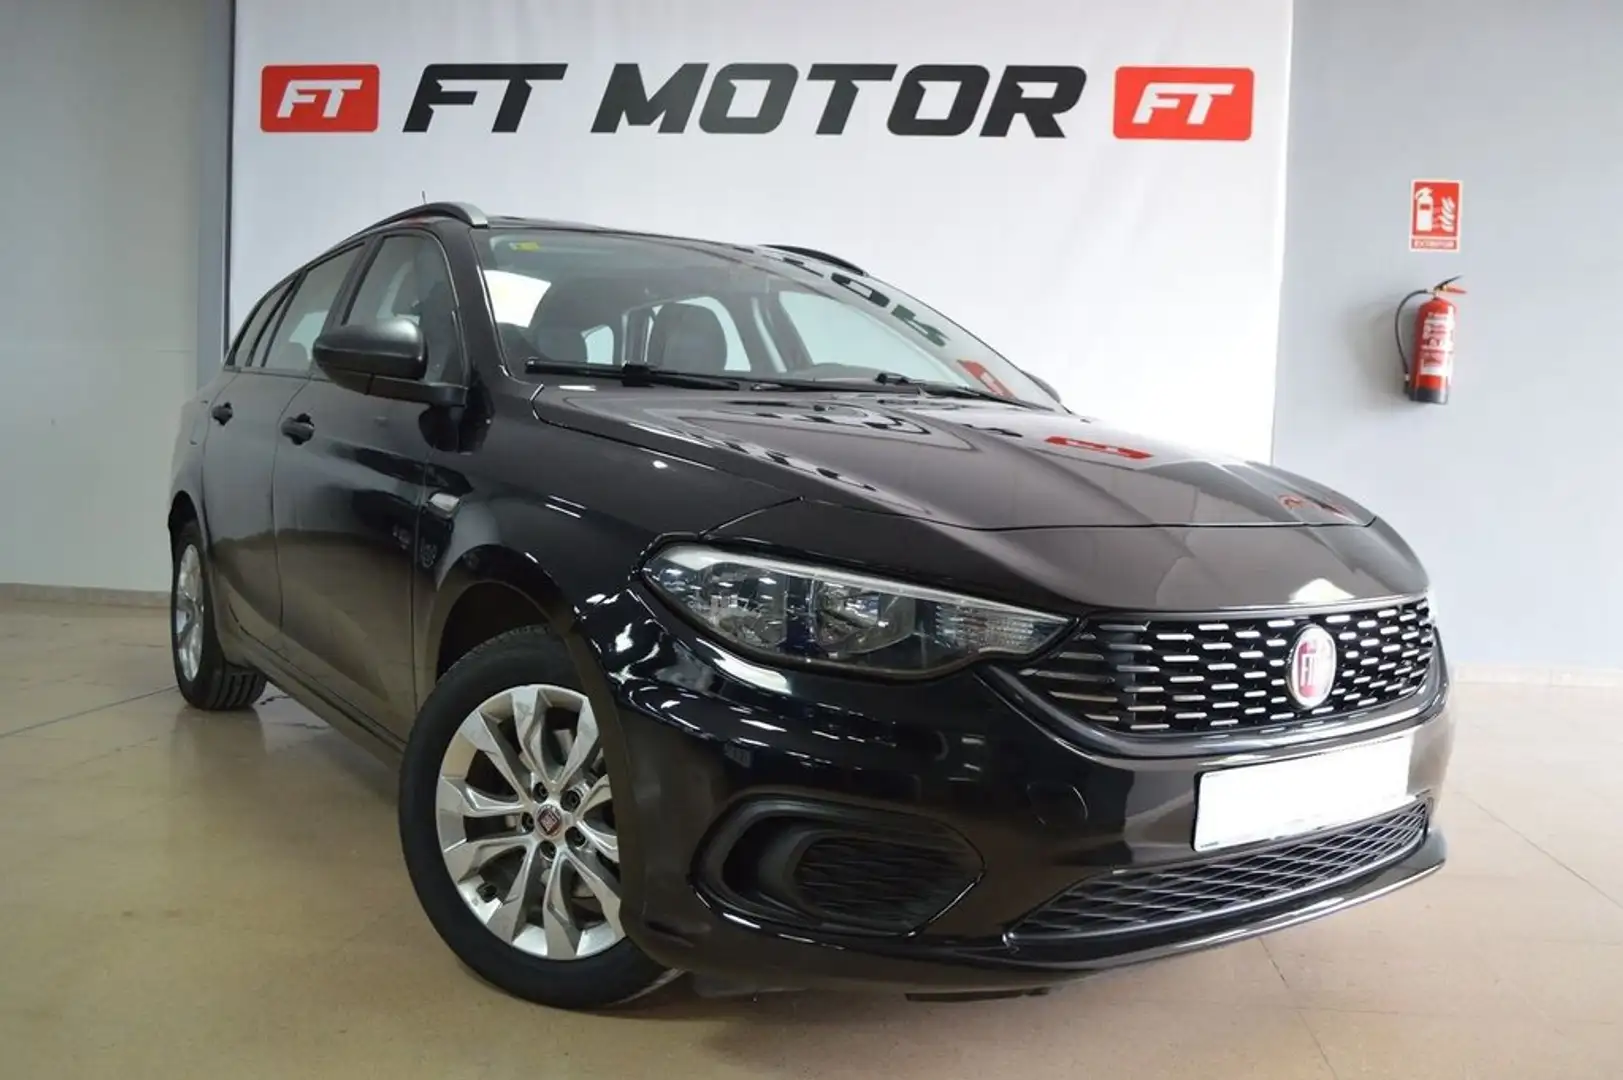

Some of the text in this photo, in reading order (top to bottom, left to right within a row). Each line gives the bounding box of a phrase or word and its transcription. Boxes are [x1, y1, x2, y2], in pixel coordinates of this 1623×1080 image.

[277, 80, 362, 118] FT
[403, 63, 1087, 138] FT MOTOR
[1132, 83, 1235, 125] FT
